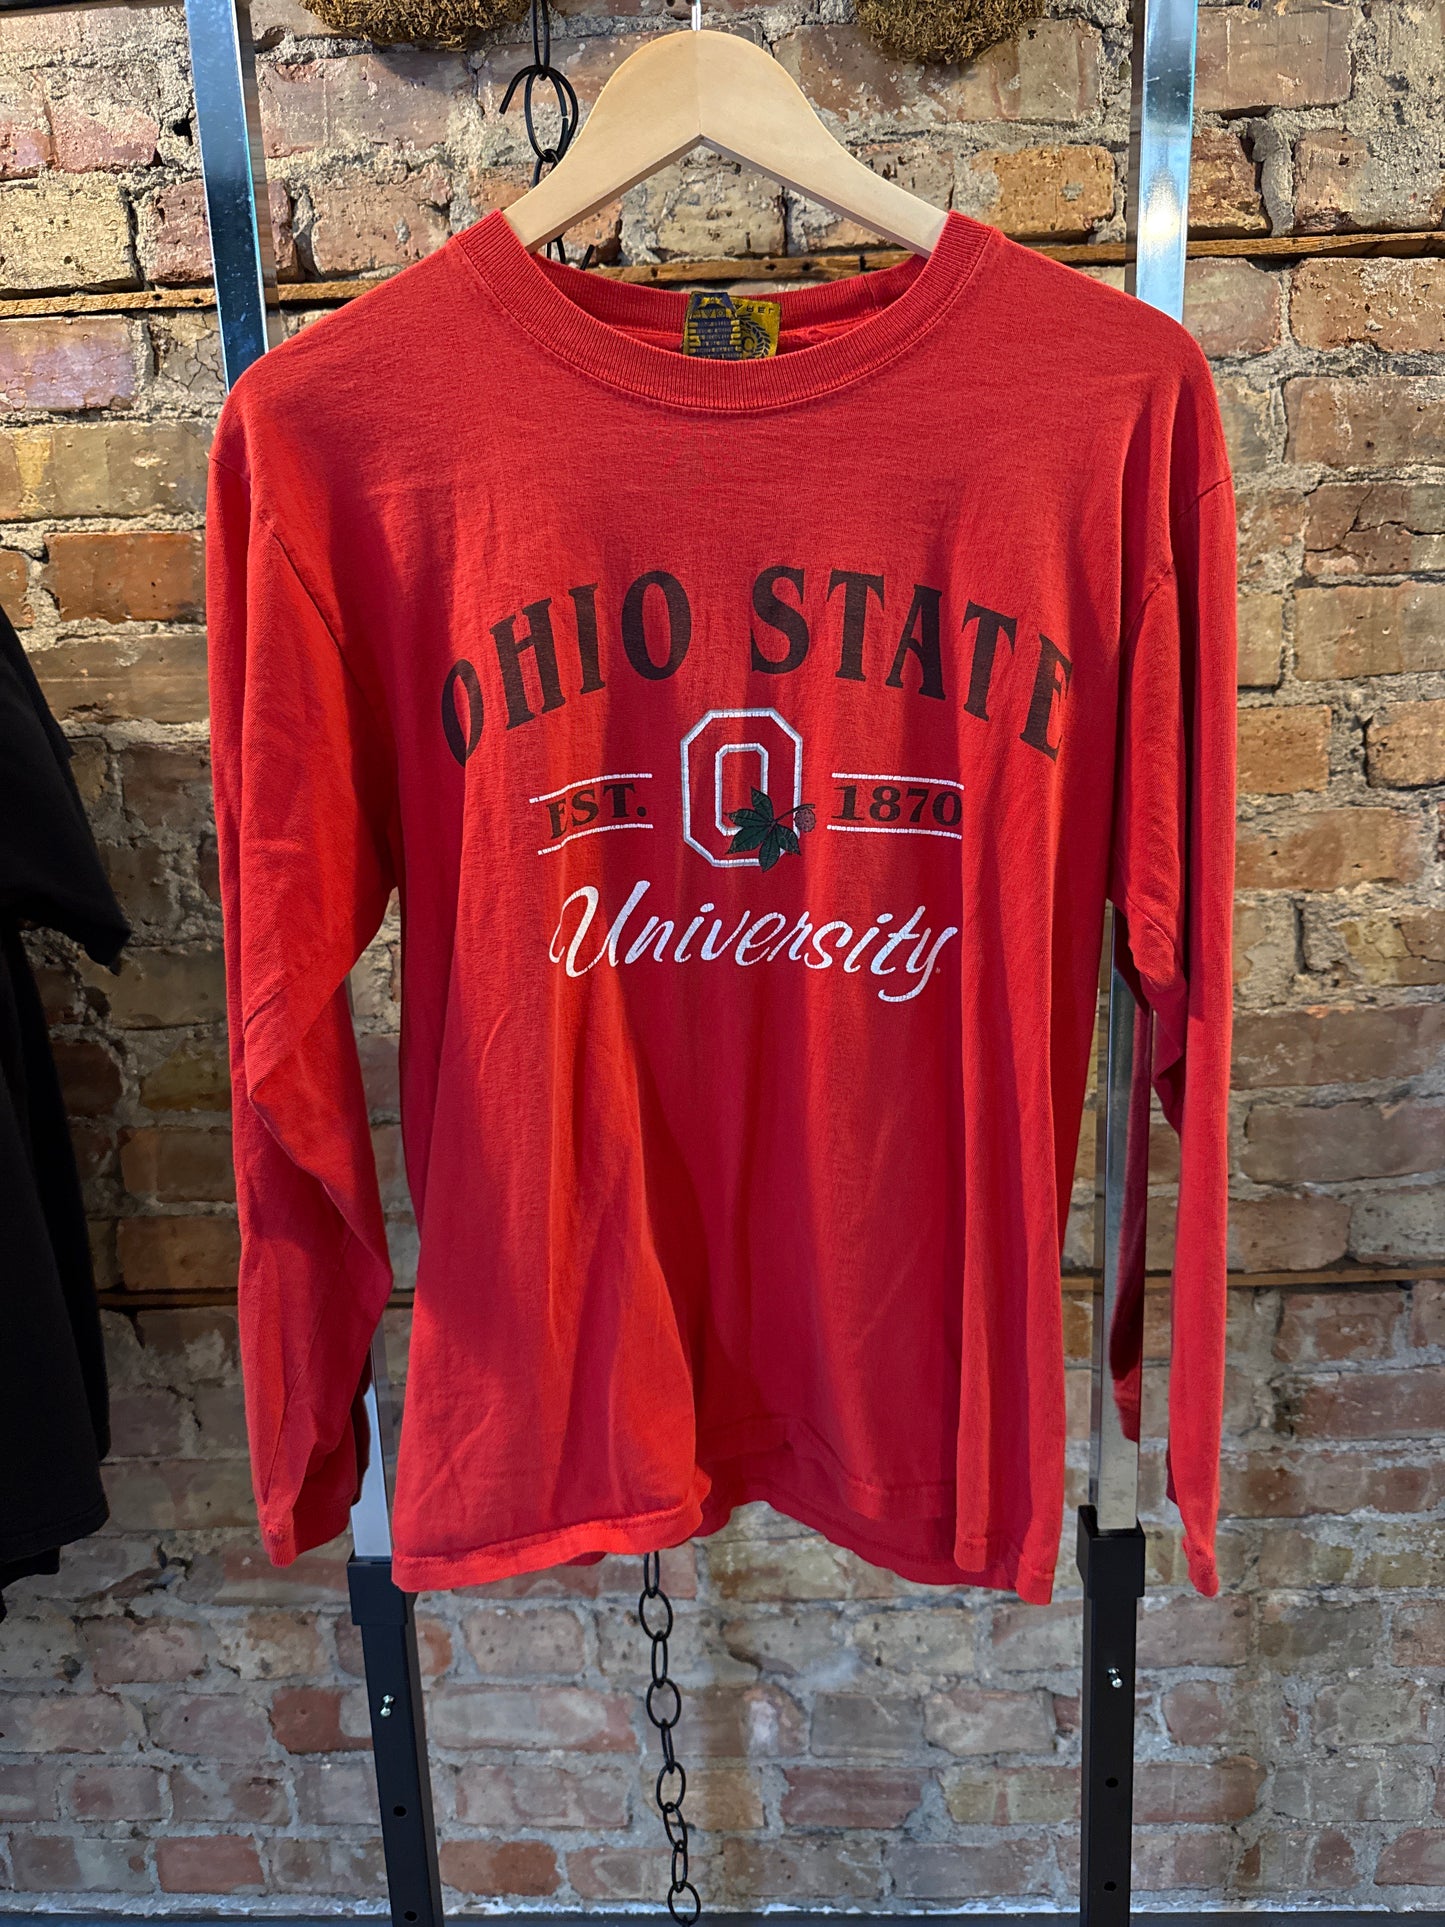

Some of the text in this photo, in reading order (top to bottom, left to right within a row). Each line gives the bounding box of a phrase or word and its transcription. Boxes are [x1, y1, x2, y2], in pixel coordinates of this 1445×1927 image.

[441, 565, 1073, 767] OHIO STATE
[546, 783, 647, 839] EST.
[831, 785, 962, 826] 1870
[549, 880, 958, 1003] University
